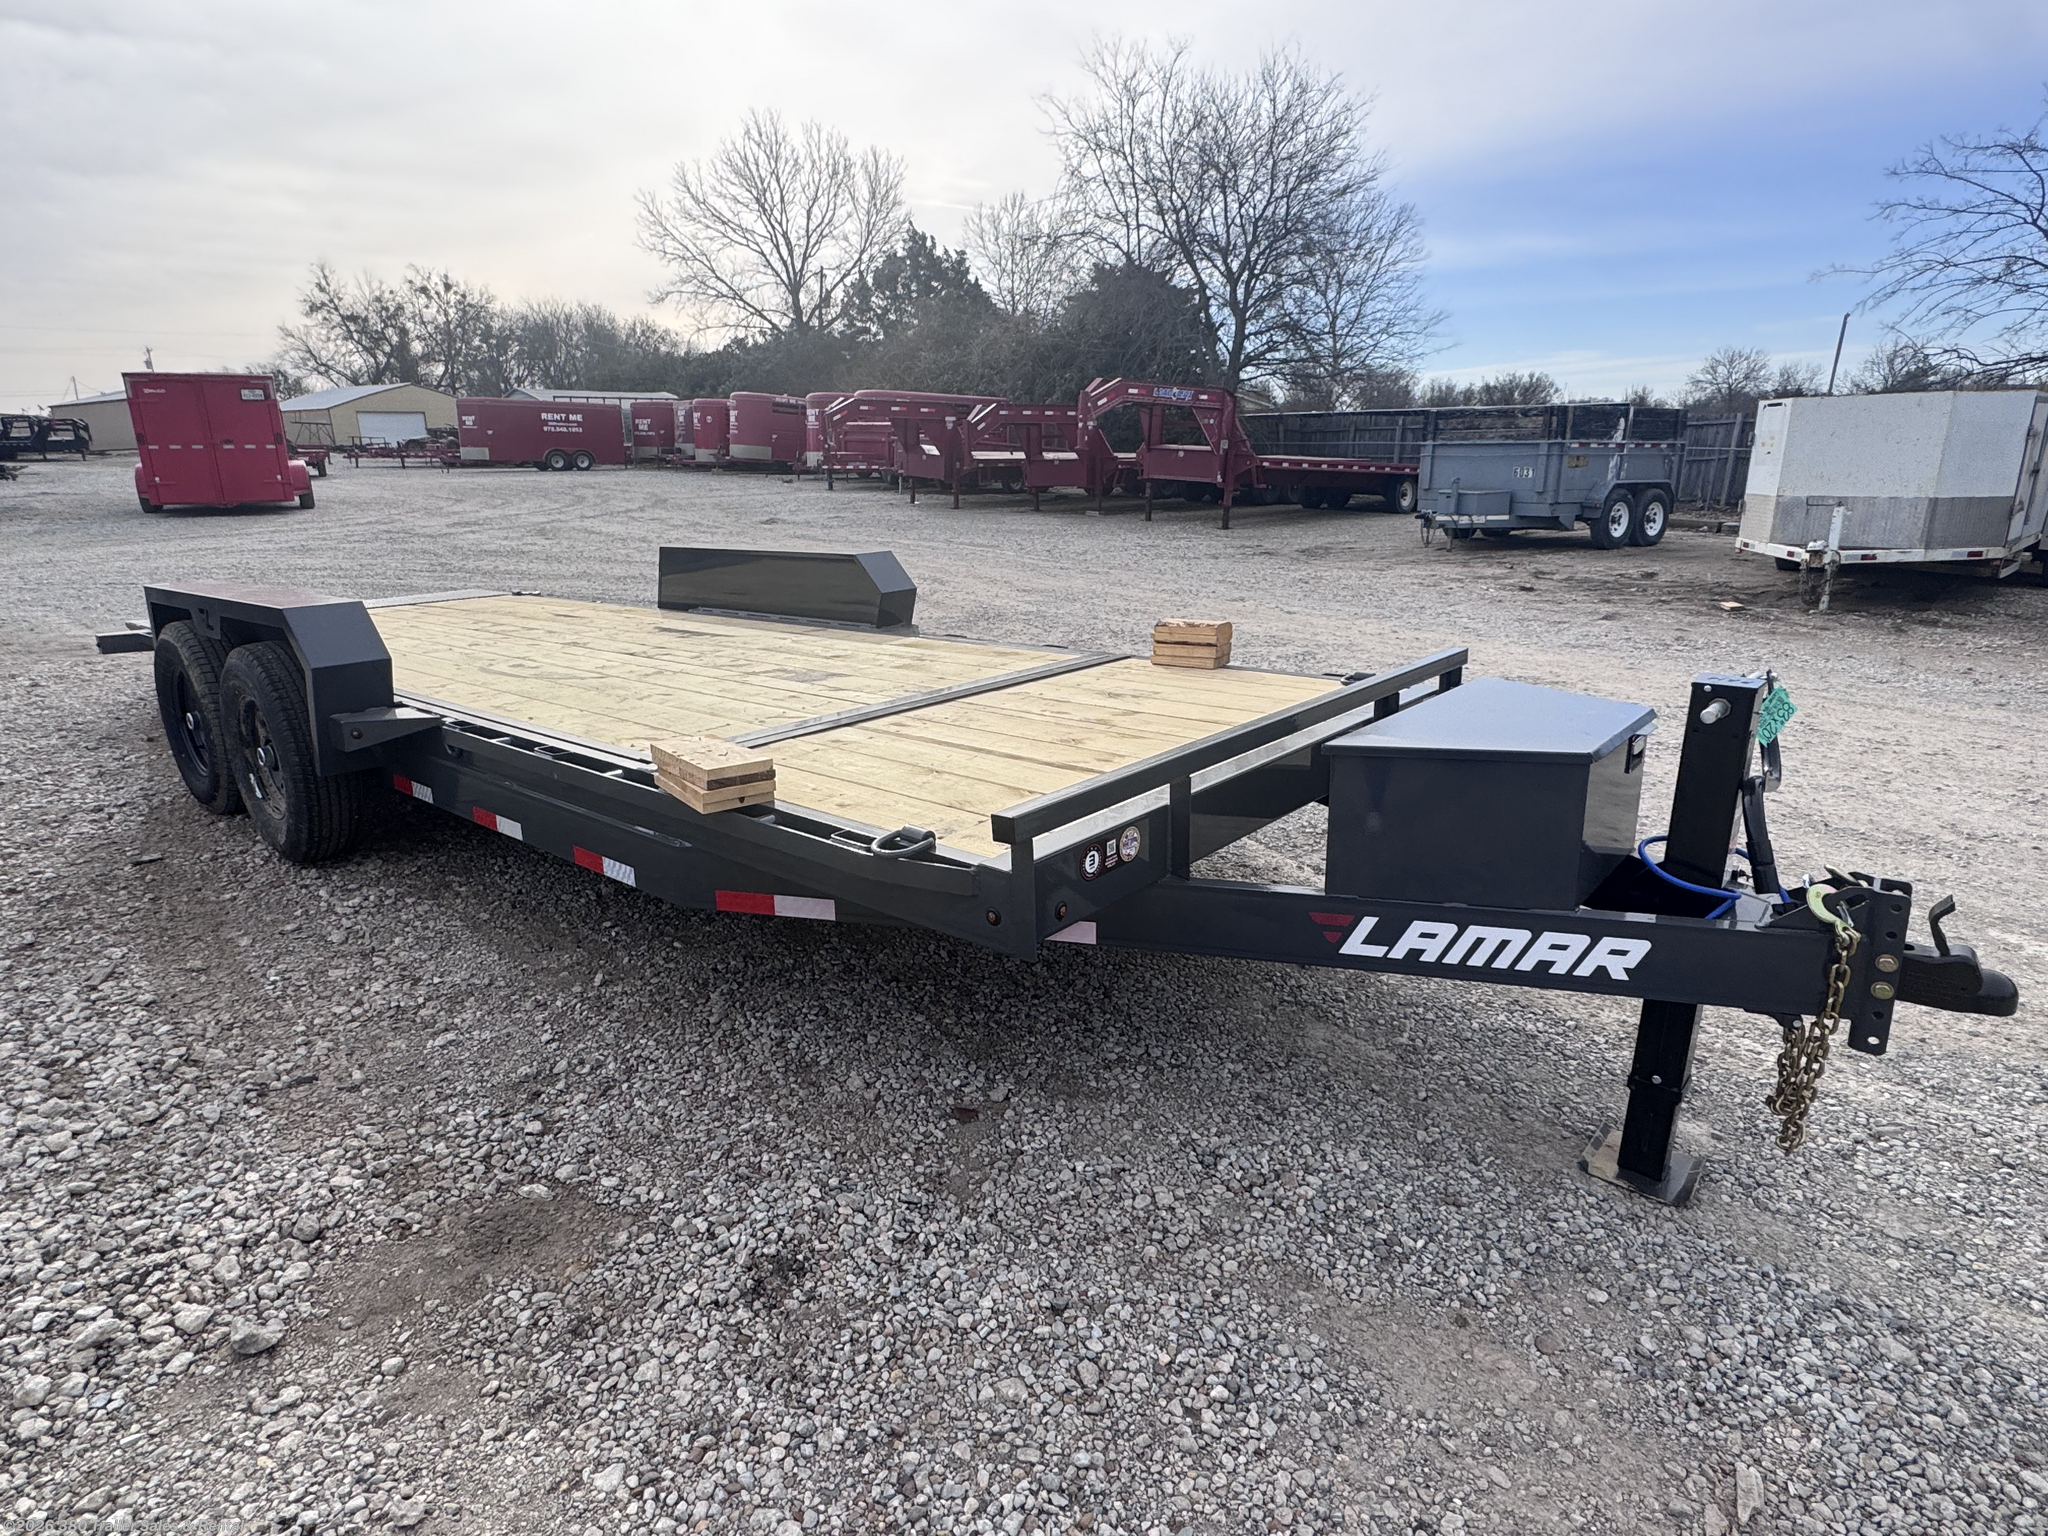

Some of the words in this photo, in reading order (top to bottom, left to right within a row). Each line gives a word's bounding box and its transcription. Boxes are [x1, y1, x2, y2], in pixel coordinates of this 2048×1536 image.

[541, 412, 566, 421] RENT
[569, 413, 583, 421] ME
[1513, 467, 1535, 478] 6031
[1338, 916, 1652, 981] LAMAR
